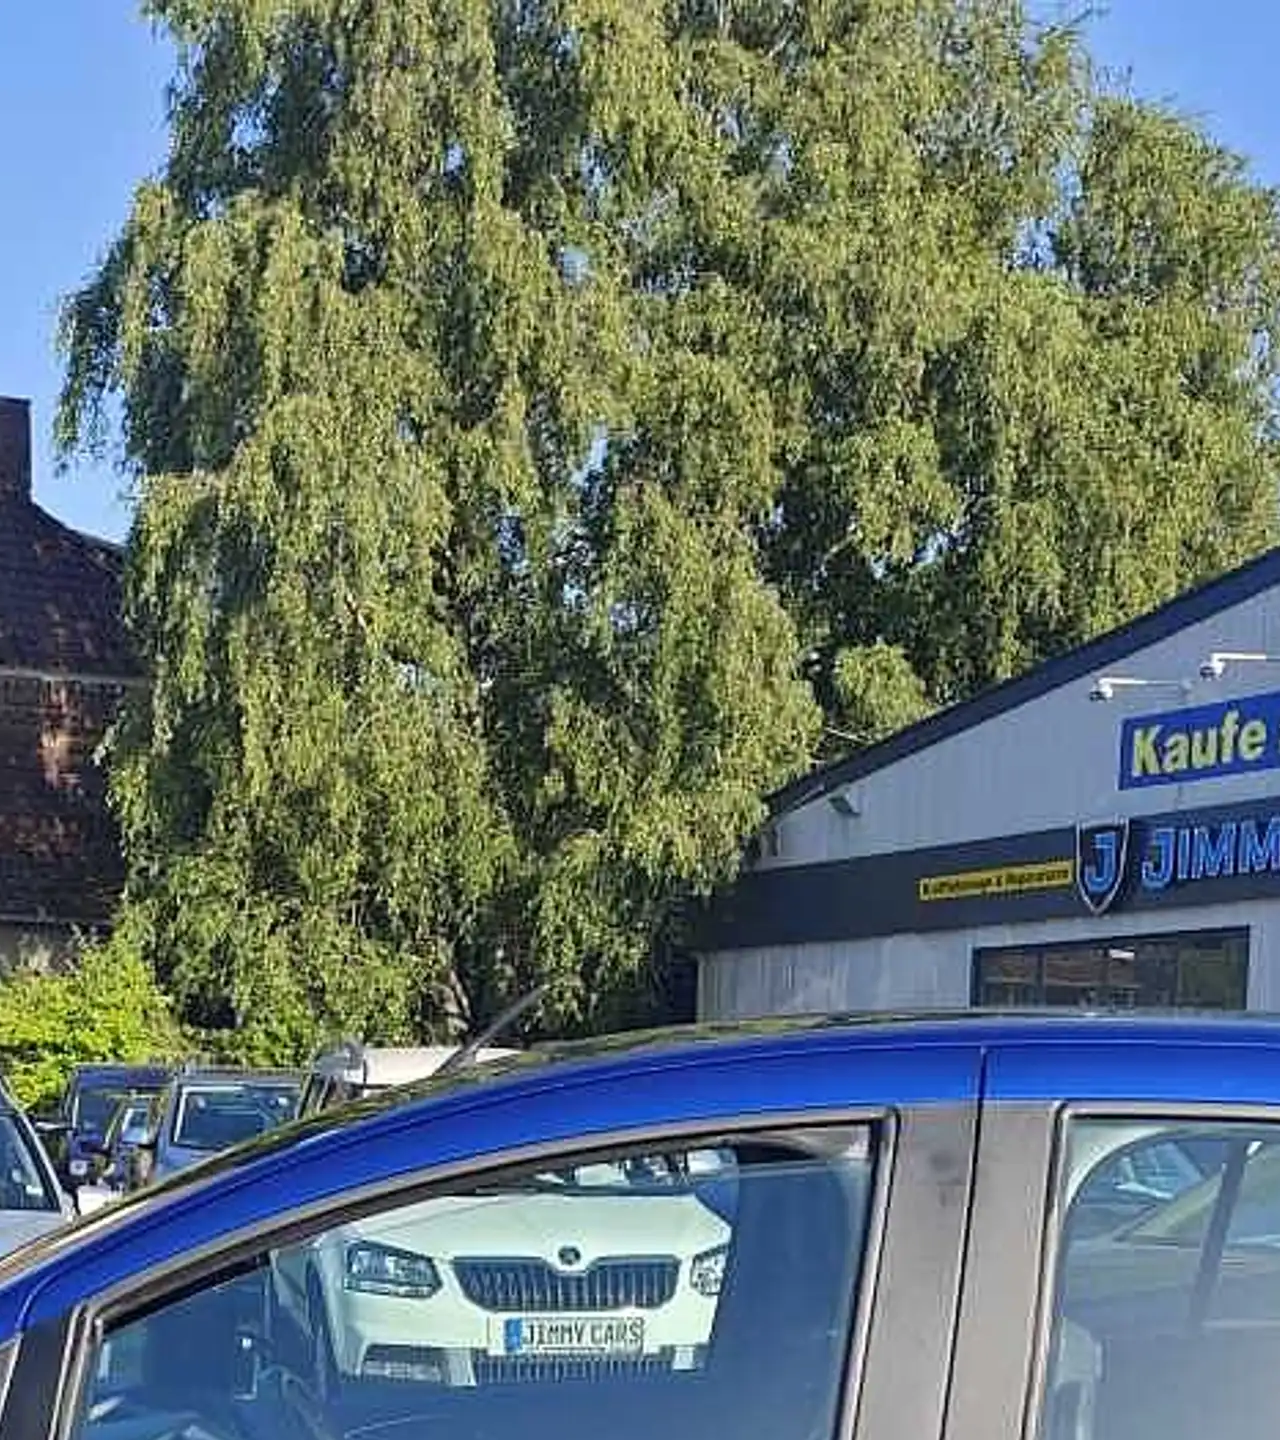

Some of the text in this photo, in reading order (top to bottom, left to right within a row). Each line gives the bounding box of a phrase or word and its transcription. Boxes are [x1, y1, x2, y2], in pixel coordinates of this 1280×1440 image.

[1132, 710, 1267, 778] Kaufe
[1083, 831, 1117, 893] J
[524, 1321, 642, 1345] JIMMY CARS
